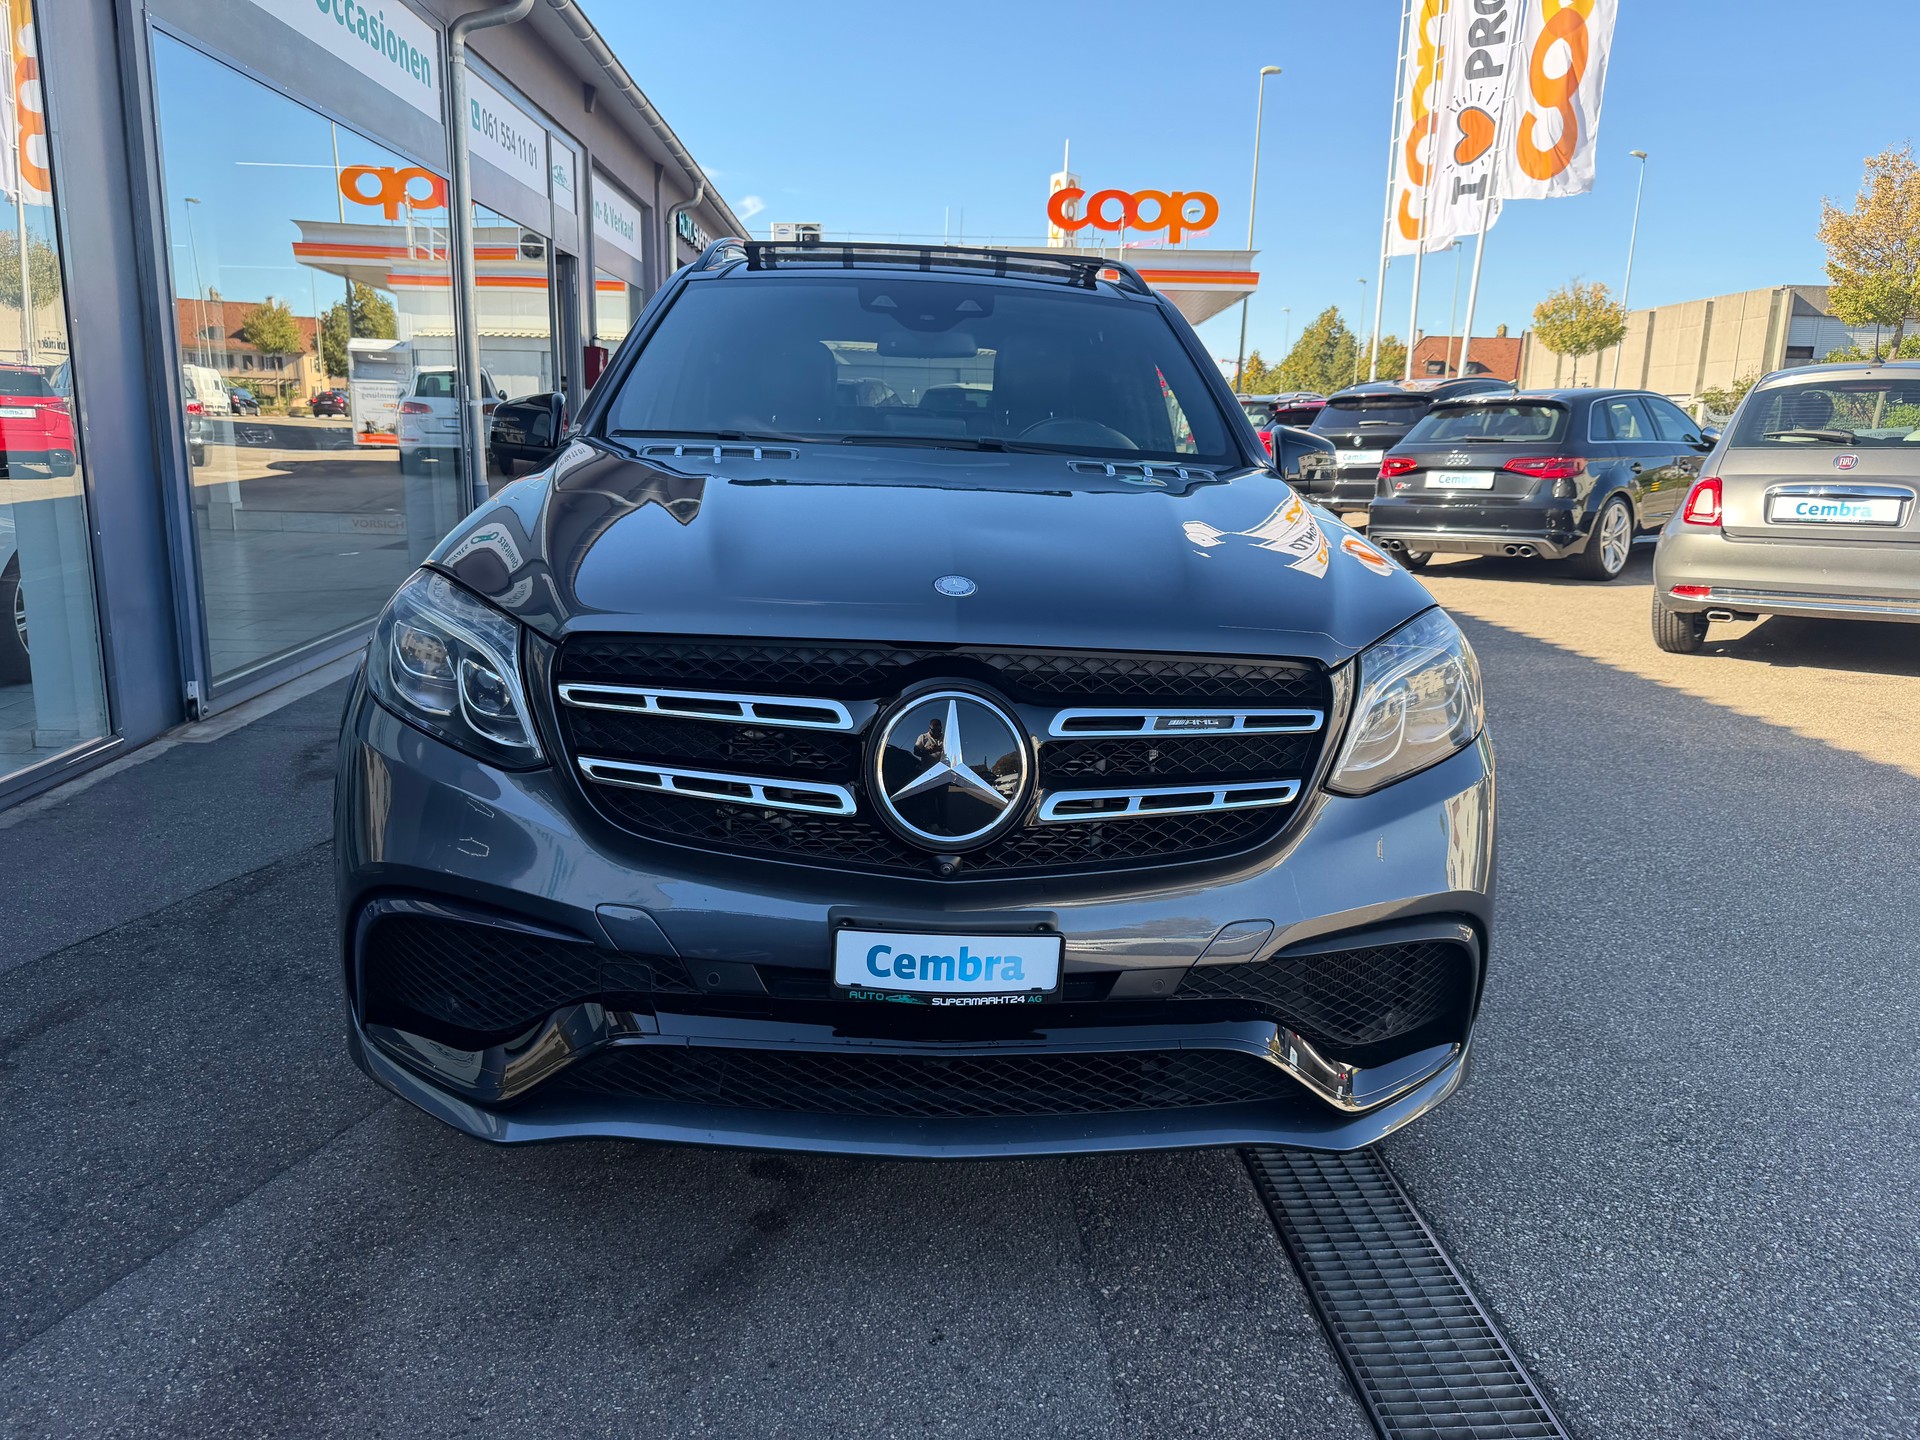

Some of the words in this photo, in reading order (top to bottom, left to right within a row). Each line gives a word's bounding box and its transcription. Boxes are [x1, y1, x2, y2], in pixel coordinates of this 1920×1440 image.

[482, 107, 498, 143] 061
[501, 121, 516, 155] 554
[518, 135, 527, 162] 11
[528, 142, 537, 170] 01
[610, 205, 634, 242] Verkauf
[1047, 187, 1219, 244] coop
[1839, 457, 1854, 466] FIAT
[1795, 501, 1872, 517] Cembra
[351, 519, 405, 530] VORSICH
[866, 944, 1026, 982] Cembra
[849, 990, 885, 1001] AUTO
[1027, 995, 1043, 1003] AG
